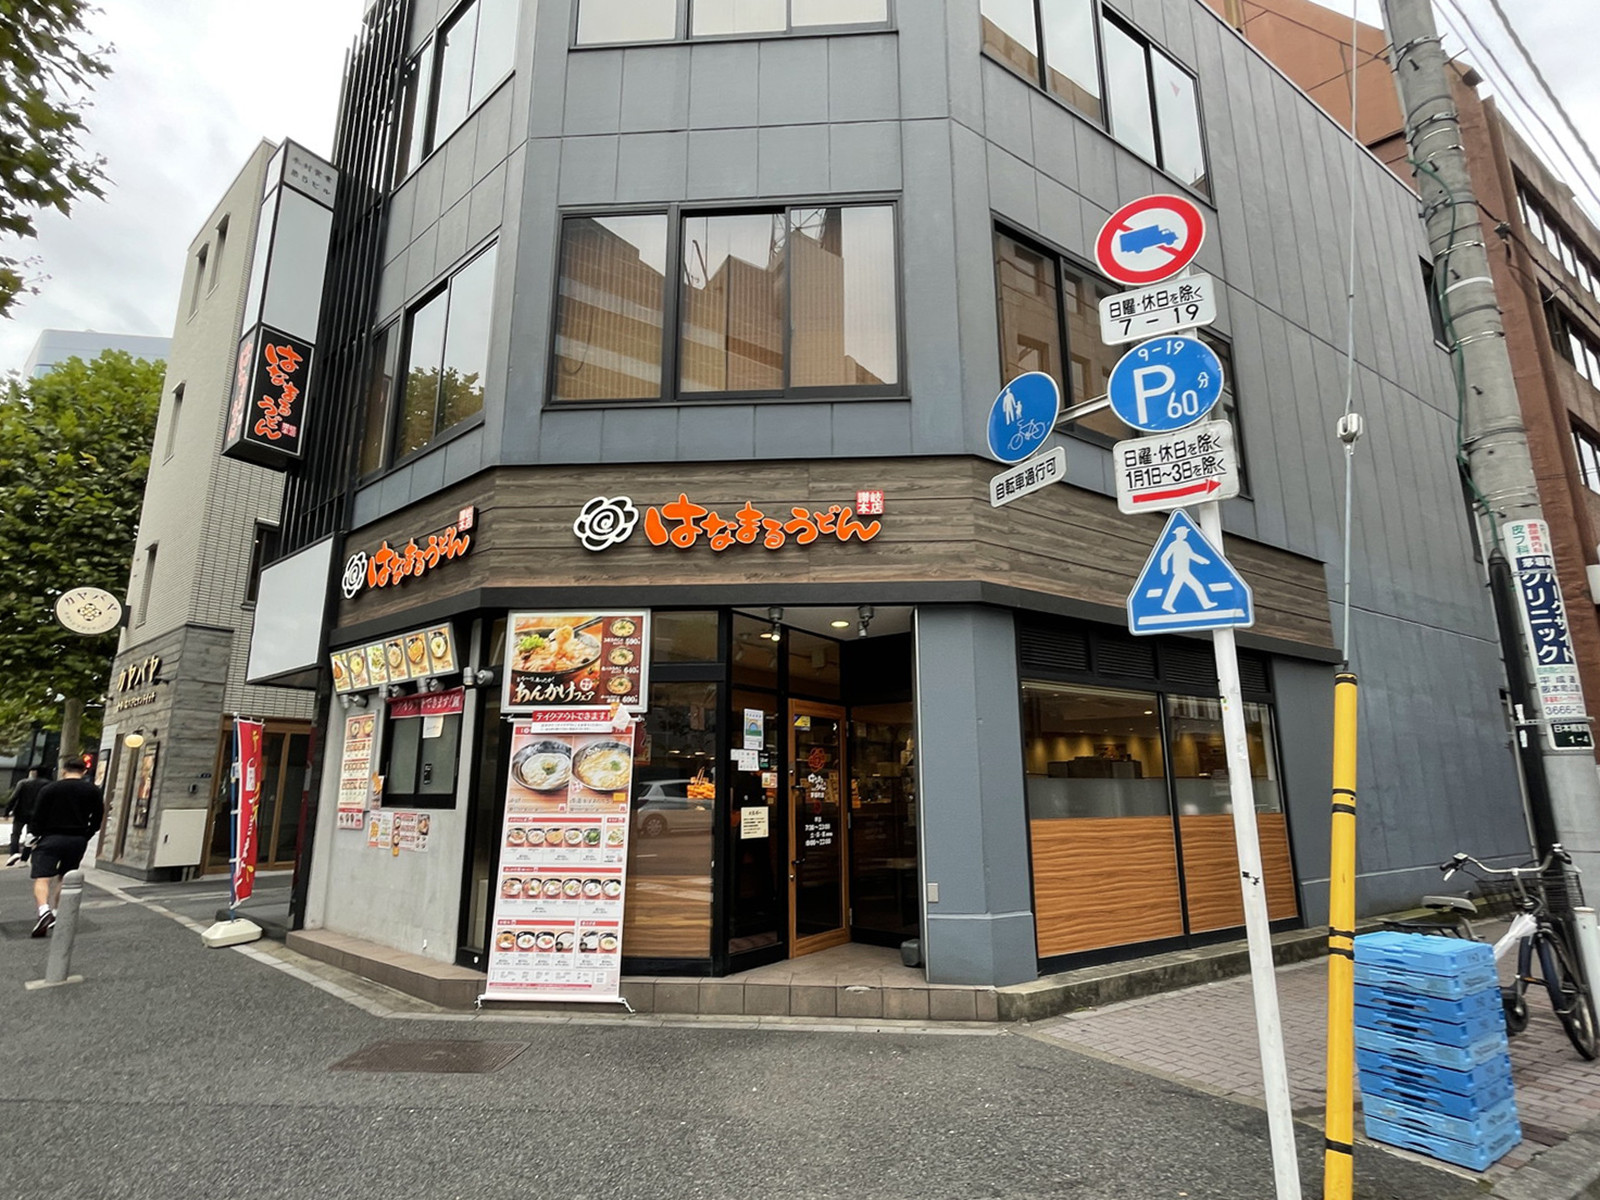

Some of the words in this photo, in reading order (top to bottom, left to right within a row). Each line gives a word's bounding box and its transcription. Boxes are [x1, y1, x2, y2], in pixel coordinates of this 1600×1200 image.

[1109, 285, 1203, 318] 日曜・休日を除く
[1138, 340, 1185, 361] 9-19
[254, 344, 303, 440] はなまるうどん
[1133, 364, 1176, 425] P
[1197, 371, 1210, 389] 分
[1167, 389, 1199, 419] 60
[1124, 433, 1223, 467] 日曜・休日を除く
[995, 457, 1058, 501] 自転車通行可
[644, 493, 882, 551] はなまるうどん
[368, 526, 470, 588] はなまるうどん
[1521, 573, 1559, 663] クリニック
[512, 680, 595, 703] あんかけフェア
